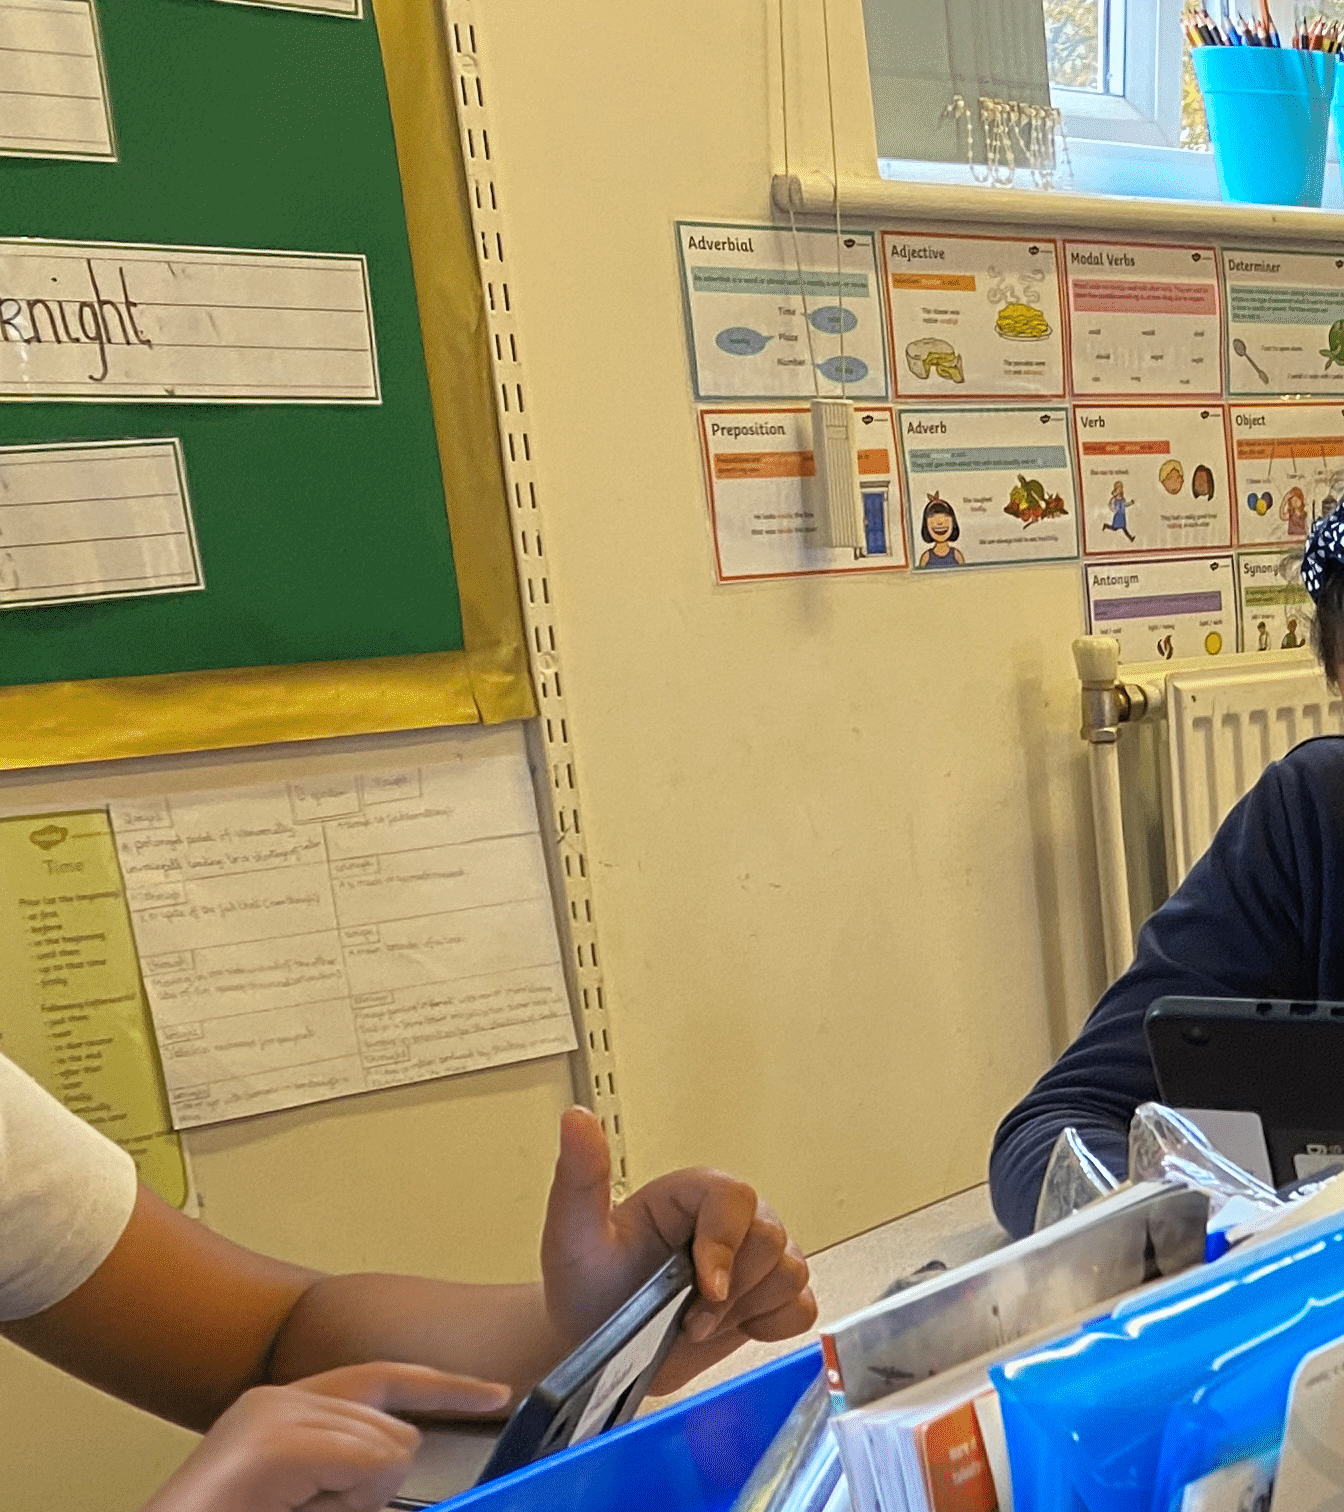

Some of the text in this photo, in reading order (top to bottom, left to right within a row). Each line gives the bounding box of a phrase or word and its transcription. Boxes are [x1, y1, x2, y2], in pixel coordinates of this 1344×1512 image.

[688, 236, 754, 252] Adverbial
[891, 245, 945, 261] Adjective
[1071, 252, 1135, 267] Modal Verbs
[1228, 259, 1281, 273] Determiner
[907, 421, 947, 435] Adverb
[1081, 415, 1105, 428] Verb
[1235, 414, 1265, 427] Object
[711, 422, 786, 440] Preposition
[1092, 573, 1140, 588] Antonym
